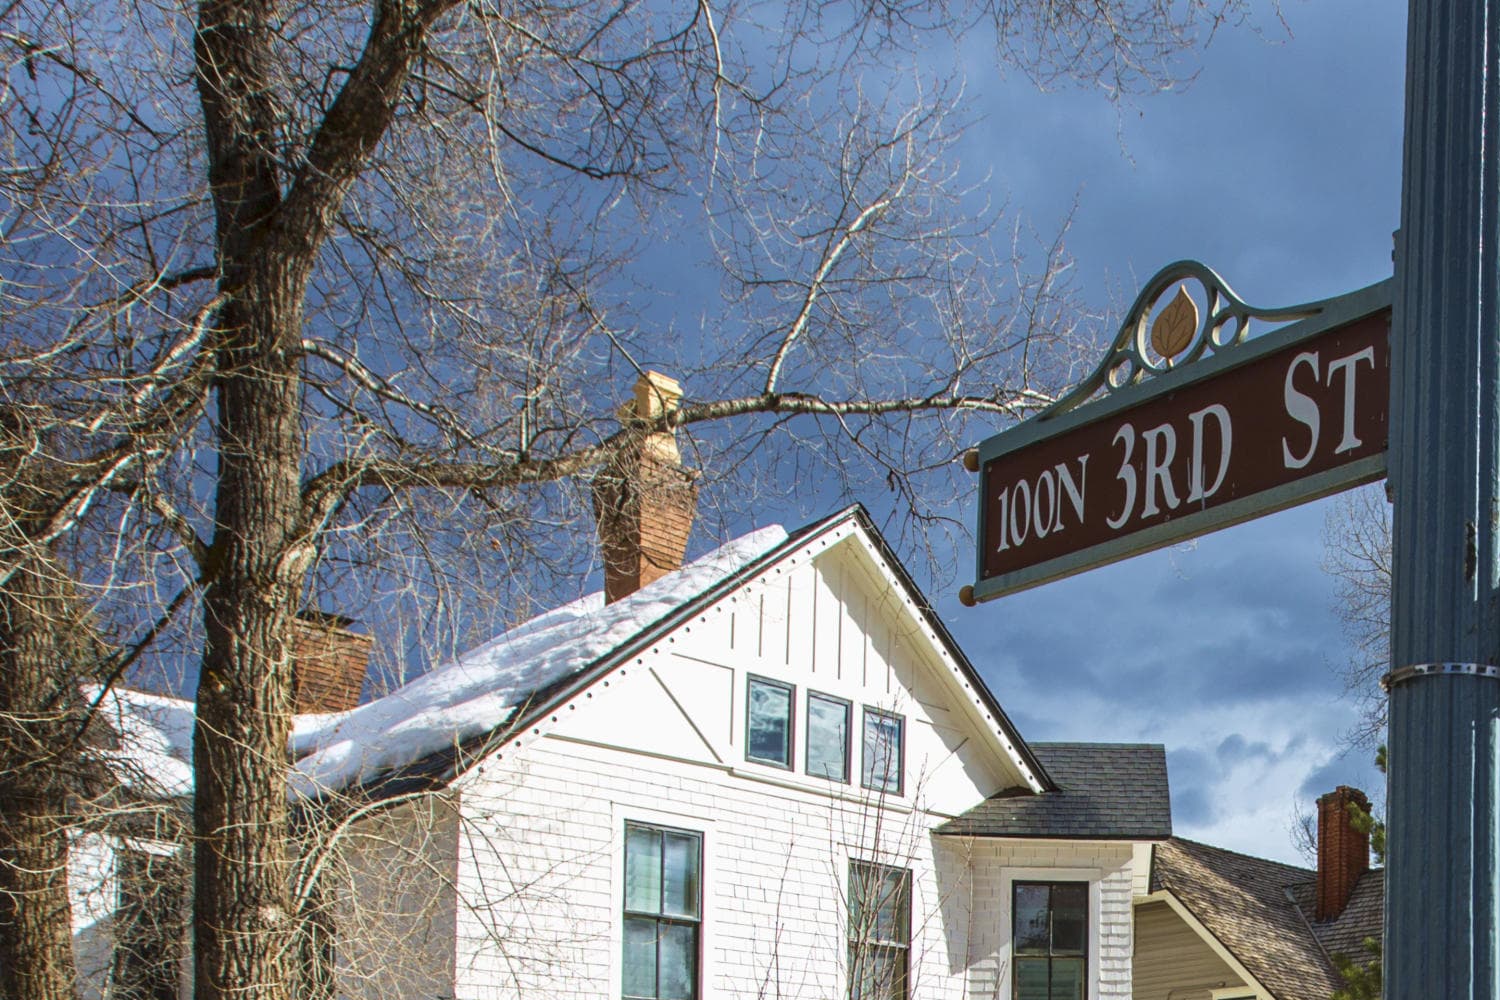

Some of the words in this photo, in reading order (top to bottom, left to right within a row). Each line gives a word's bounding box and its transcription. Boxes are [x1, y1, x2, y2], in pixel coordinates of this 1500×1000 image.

[997, 454, 1089, 552] 100N
[1106, 403, 1233, 530] 3RD
[1282, 346, 1375, 469] ST
